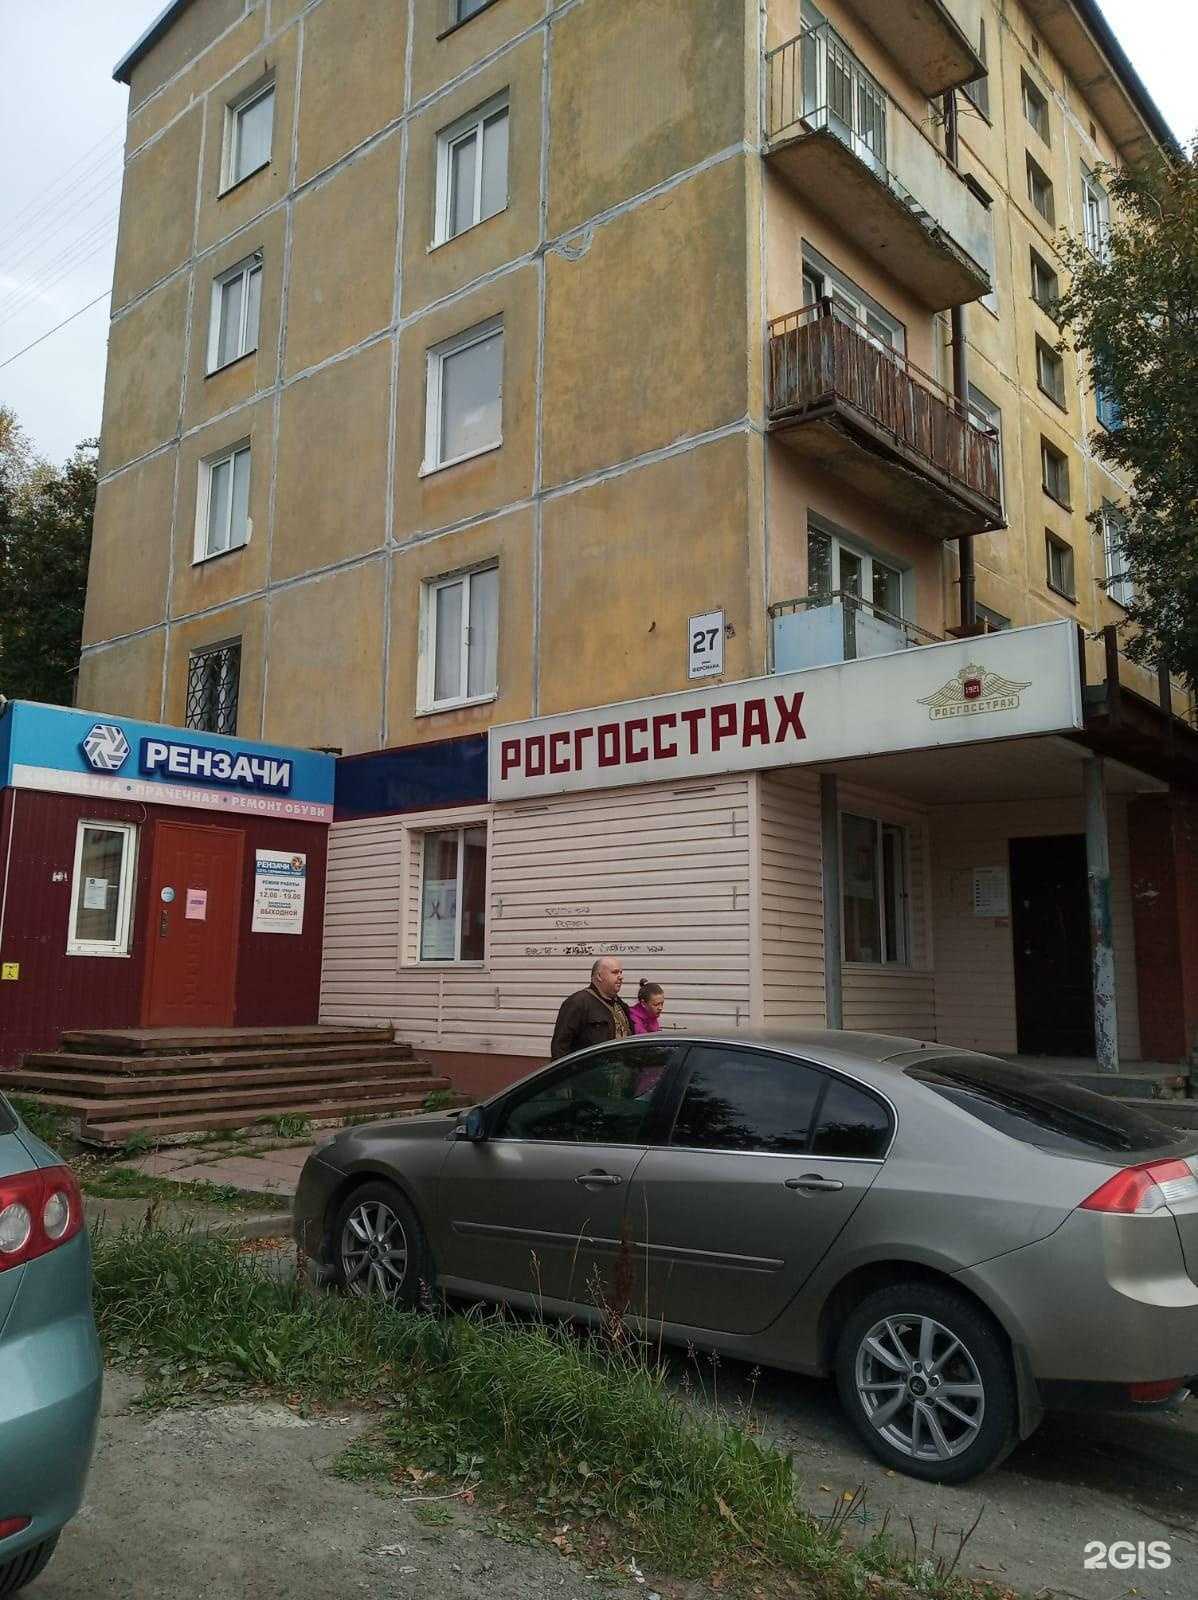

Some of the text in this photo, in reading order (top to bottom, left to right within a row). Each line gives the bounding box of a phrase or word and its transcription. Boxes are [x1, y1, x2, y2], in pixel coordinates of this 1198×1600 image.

[693, 628, 719, 653] 27
[965, 685, 979, 694] 1921
[934, 698, 1015, 717] РОСГОССТРАХ
[501, 691, 807, 780] РОСГОССТРАХ
[146, 742, 290, 787] РЕНЗАЧИ
[135, 784, 220, 804] ПРАЧЕЧНАЯ
[231, 797, 281, 812] РЕМОНТ
[285, 803, 326, 817] ОБУВИ
